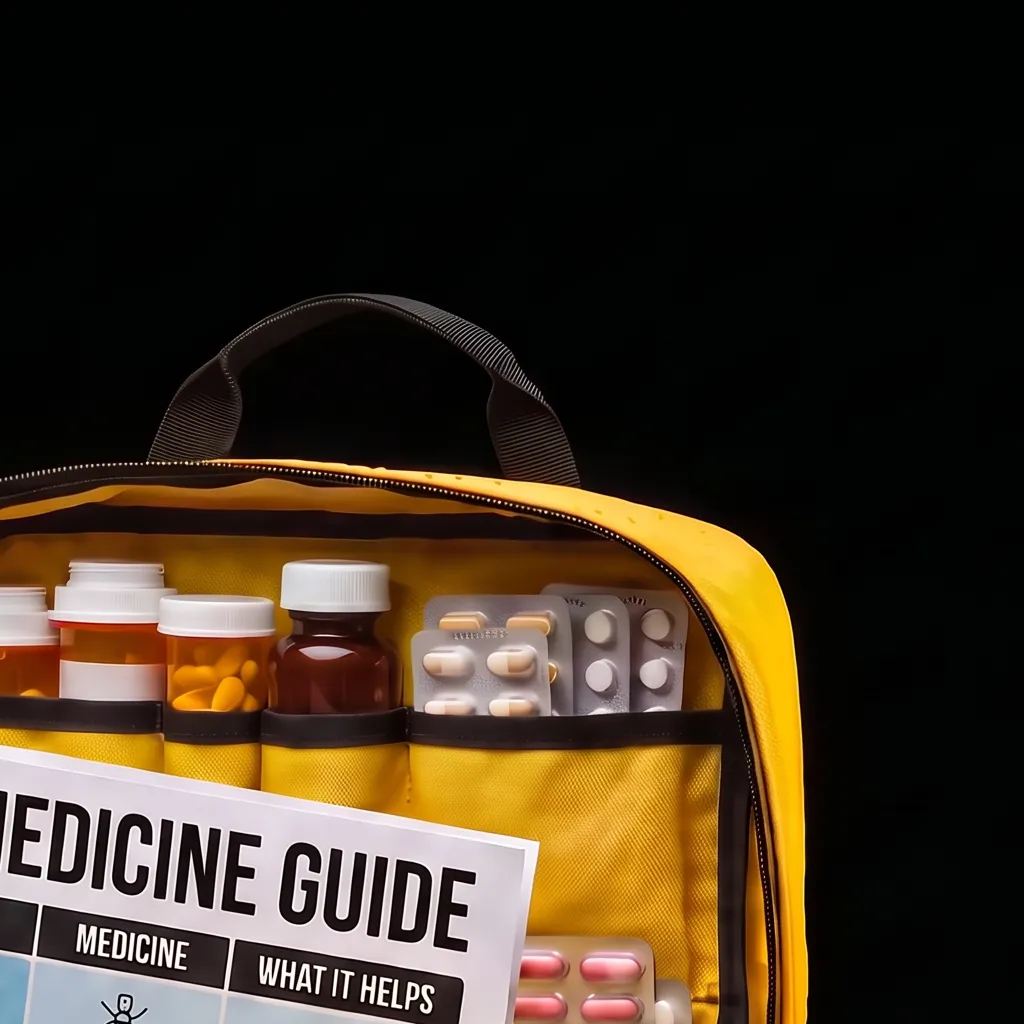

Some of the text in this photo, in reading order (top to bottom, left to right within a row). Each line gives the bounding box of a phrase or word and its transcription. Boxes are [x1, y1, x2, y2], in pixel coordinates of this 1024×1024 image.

[279, 841, 477, 952] GUIDE
[75, 923, 190, 971] MEDICINE
[258, 955, 436, 1015] WHAT IT HELPS
